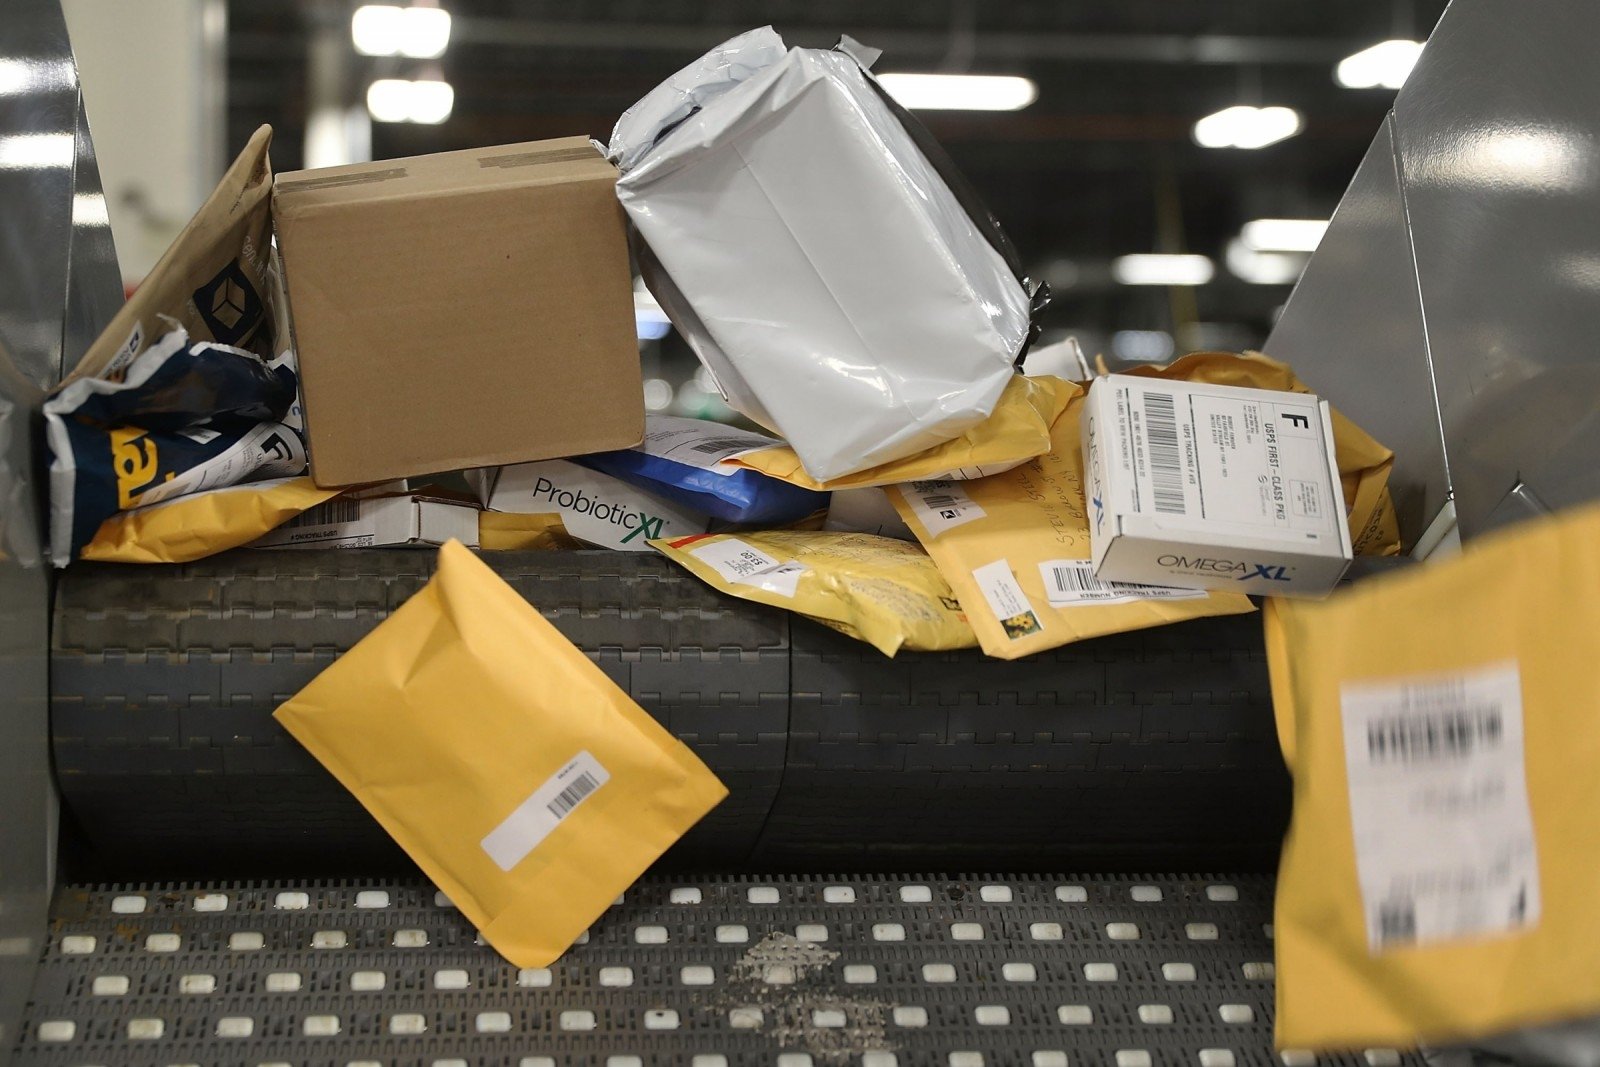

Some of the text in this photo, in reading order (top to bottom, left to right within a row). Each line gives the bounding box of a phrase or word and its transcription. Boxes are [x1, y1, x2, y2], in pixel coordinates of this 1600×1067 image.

[1281, 413, 1308, 429] F
[1182, 424, 1190, 438] USPS
[260, 432, 293, 461] F
[1184, 440, 1194, 467] TRACKING
[1264, 422, 1275, 443] USPS
[1274, 503, 1286, 520] PKG
[295, 532, 323, 540] TRACKING
[1153, 589, 1172, 597] USPS
